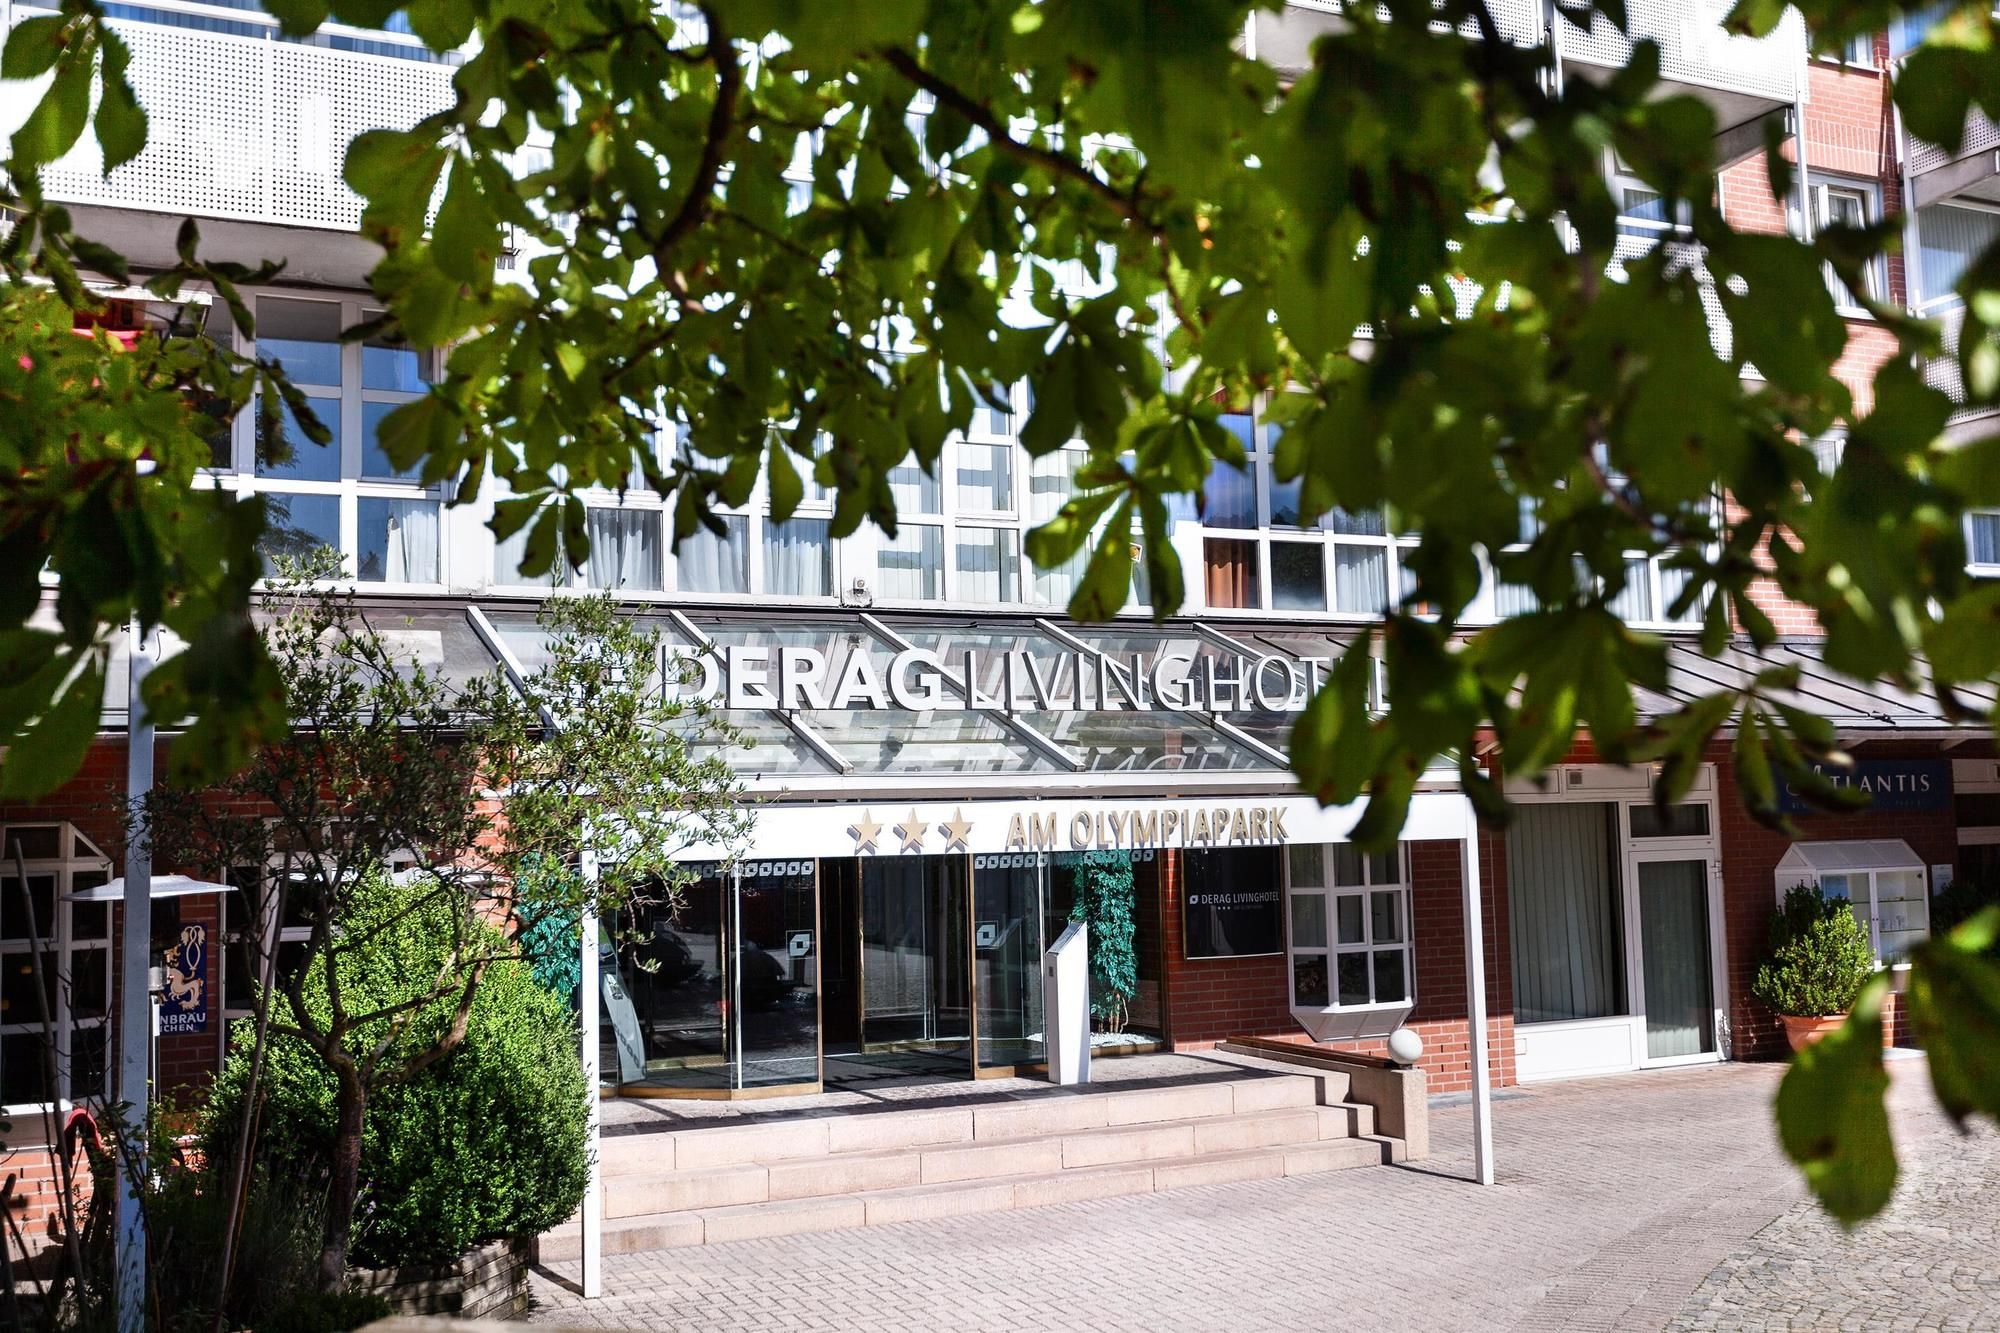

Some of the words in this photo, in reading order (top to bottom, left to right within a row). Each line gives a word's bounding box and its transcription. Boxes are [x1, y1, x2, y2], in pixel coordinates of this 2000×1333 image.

[662, 645, 942, 711] DERAG
[964, 650, 1391, 712] LIVINGHOTL
[1007, 811, 1057, 848] AM
[1071, 806, 1289, 848] OLYMPIAPARK
[1201, 893, 1232, 905] DERAG
[1233, 891, 1280, 904] LIVINGHOTEL
